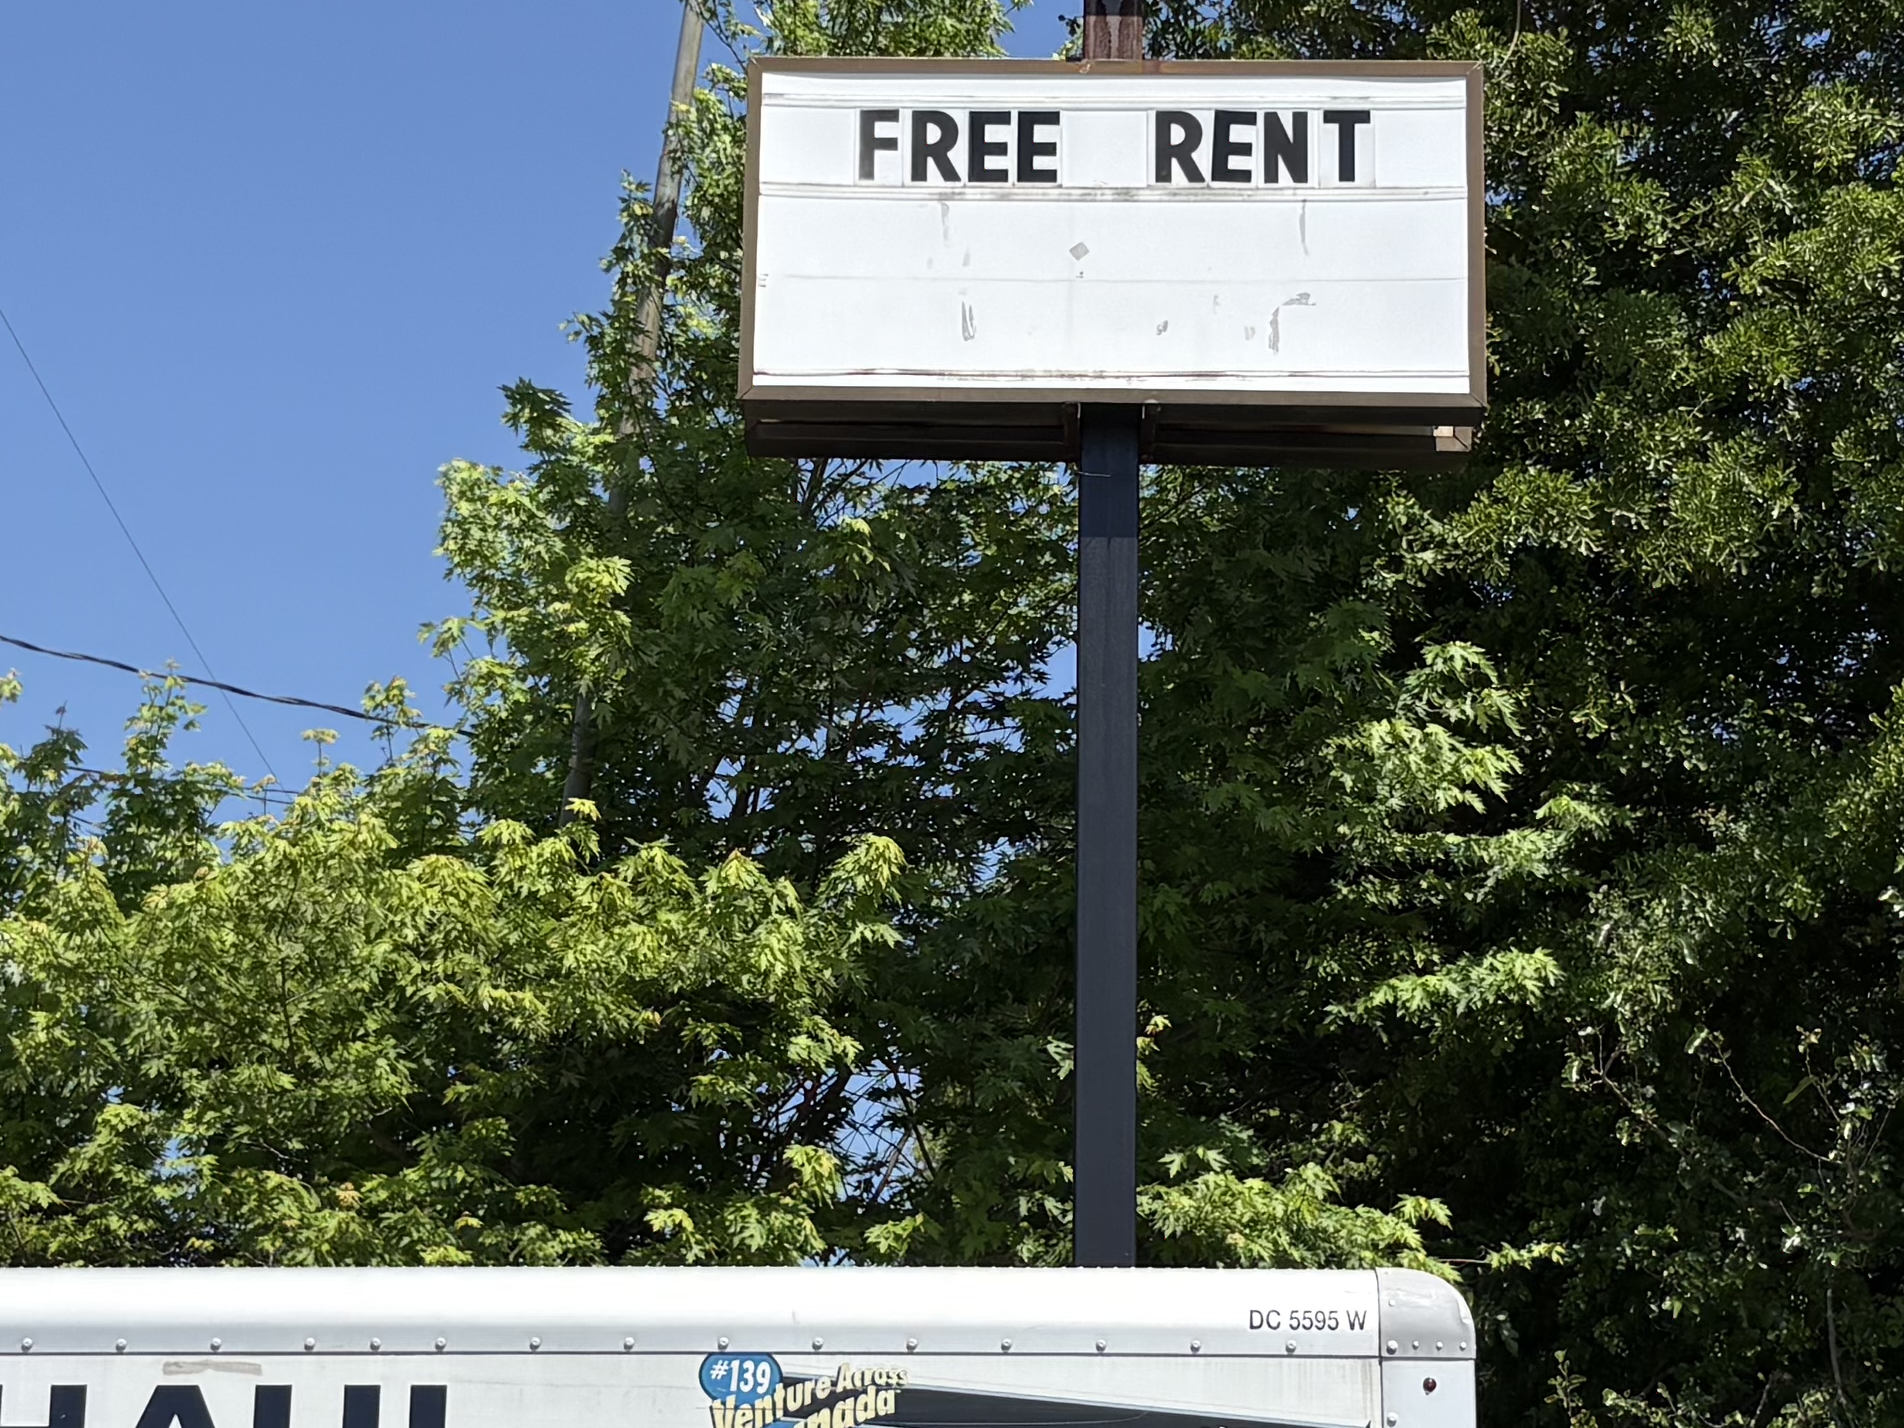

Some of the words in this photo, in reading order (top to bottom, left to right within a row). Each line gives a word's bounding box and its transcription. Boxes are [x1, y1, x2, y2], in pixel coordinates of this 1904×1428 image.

[857, 109, 1062, 184] FREE
[1154, 109, 1372, 184] RENT
[1249, 1309, 1281, 1330] DC
[1289, 1310, 1339, 1331] 5595
[1346, 1310, 1367, 1331] W
[709, 1359, 772, 1394] #139
[836, 1362, 909, 1393] Across
